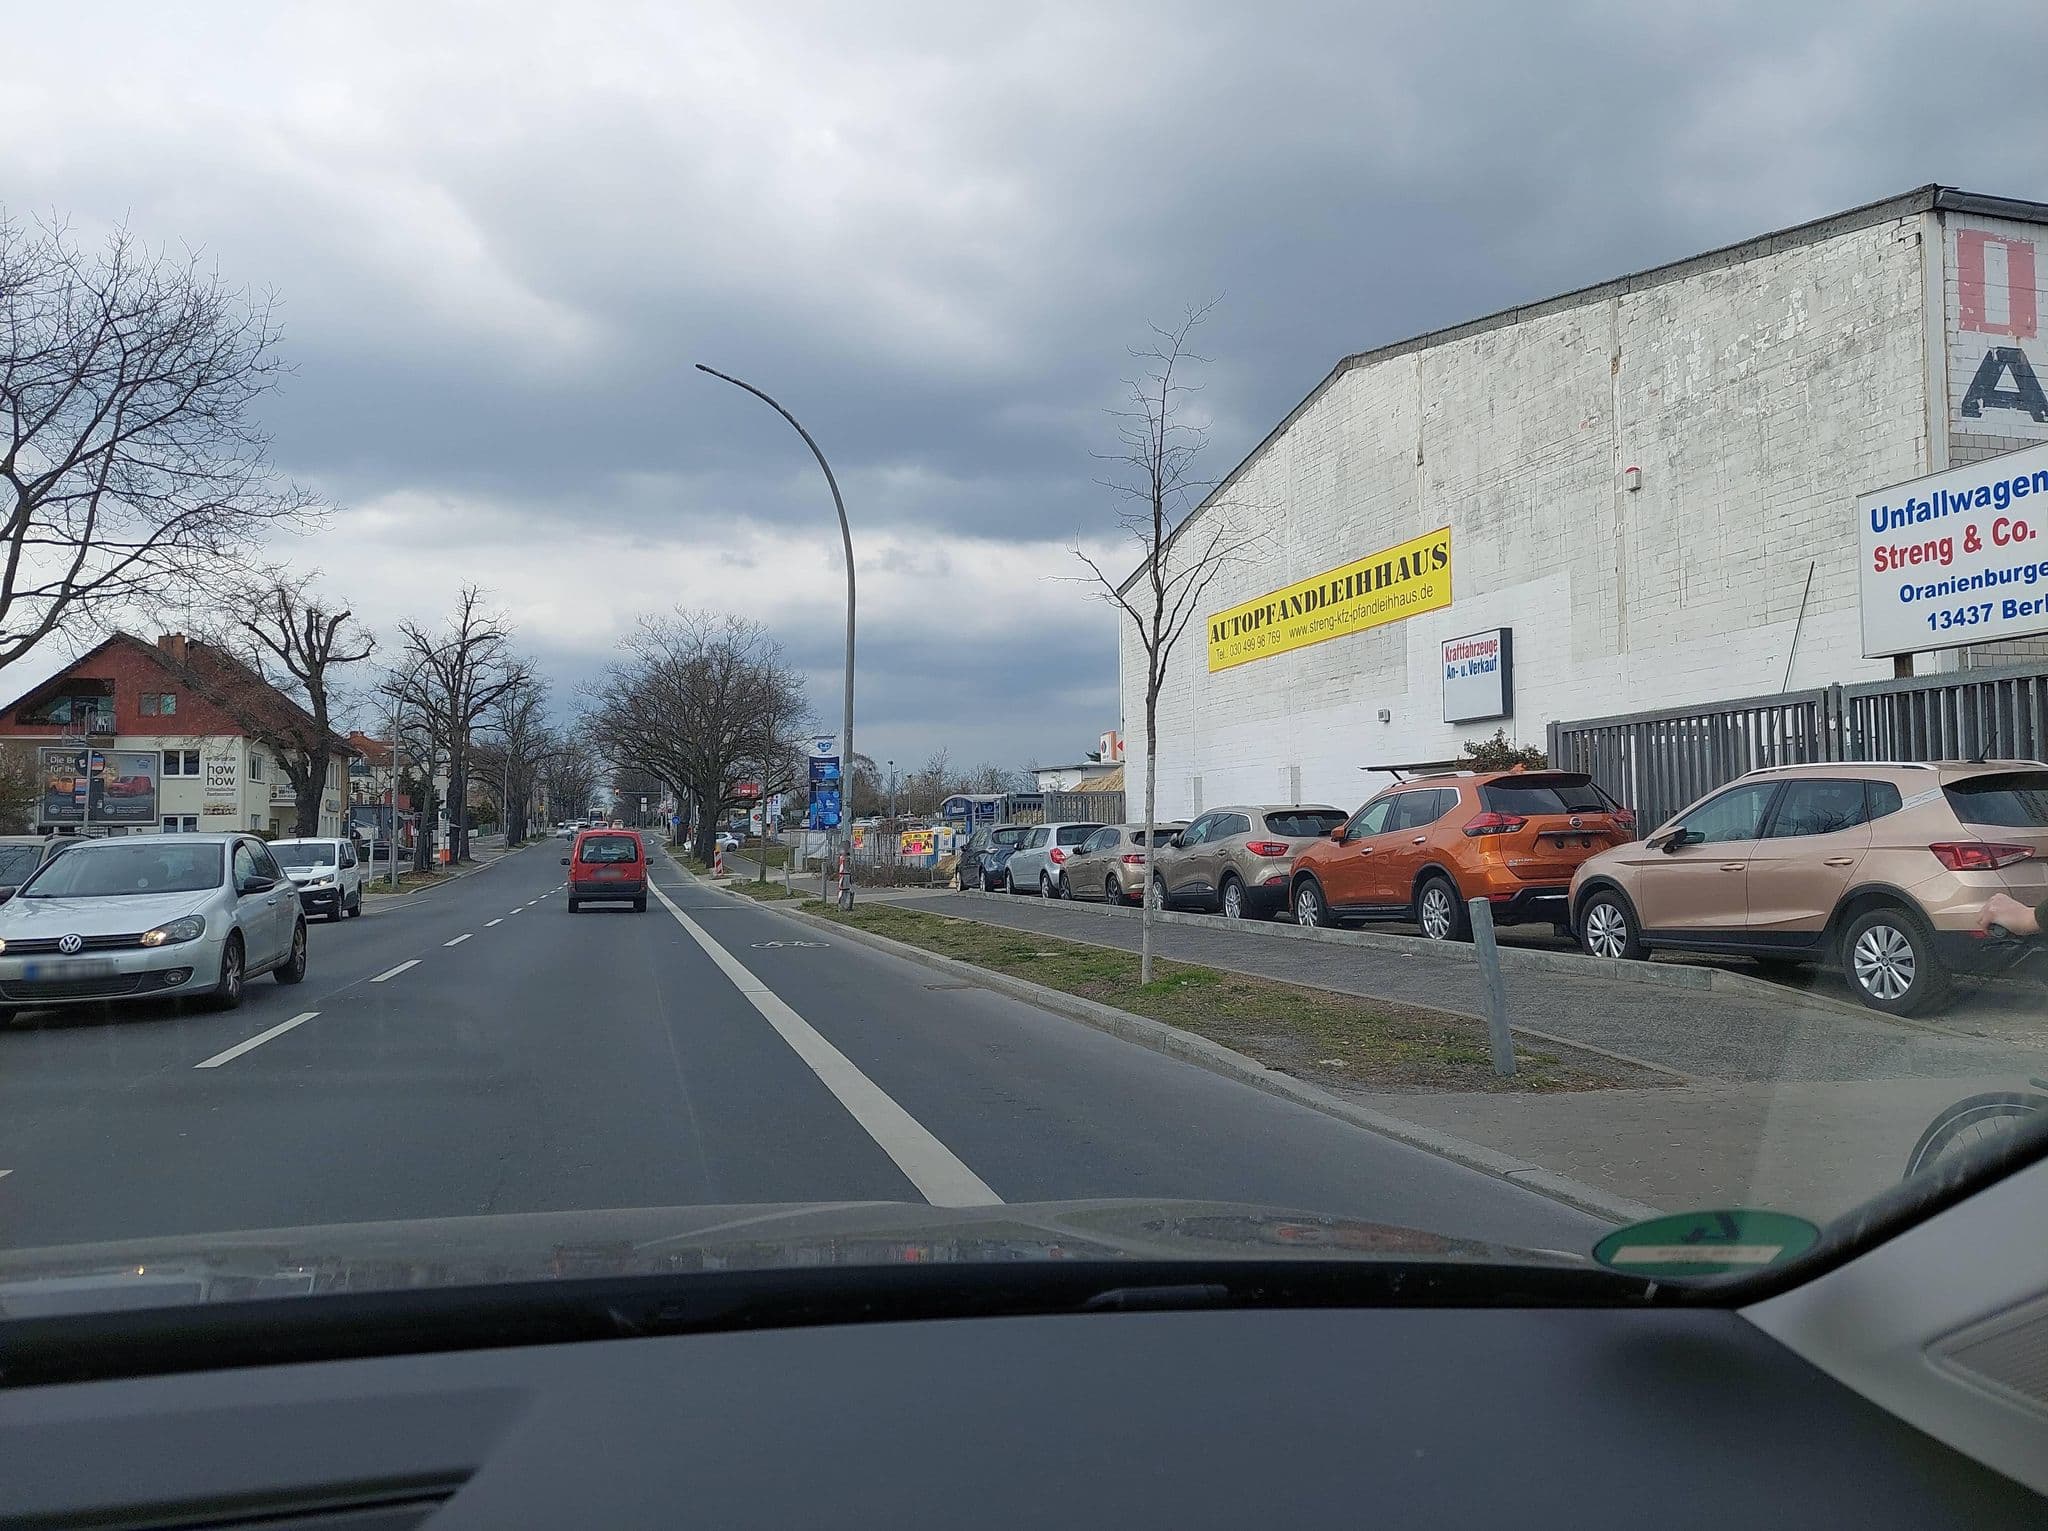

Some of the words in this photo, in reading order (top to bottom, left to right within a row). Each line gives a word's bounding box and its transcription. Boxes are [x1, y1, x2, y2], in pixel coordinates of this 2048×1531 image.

[1871, 469, 2048, 533] Unfallwagen
[1874, 537, 1953, 572] Streng
[1963, 524, 1983, 554] &
[1992, 517, 2036, 547] Co.
[1210, 542, 1448, 644] AUTOPFANDLEIHHAUS
[1229, 642, 1242, 657] 030
[1243, 637, 1256, 652] 499
[1267, 629, 1281, 645] 769
[1289, 583, 1434, 639] www.streng-kfz-pfandleihhaus.de
[1927, 603, 1993, 631] 13437
[1445, 638, 1498, 664] Kraftfahrzeuge
[1446, 664, 1459, 681] An-
[1468, 654, 1497, 676] Verkauf
[206, 775, 236, 786] how
[207, 762, 236, 774] how
